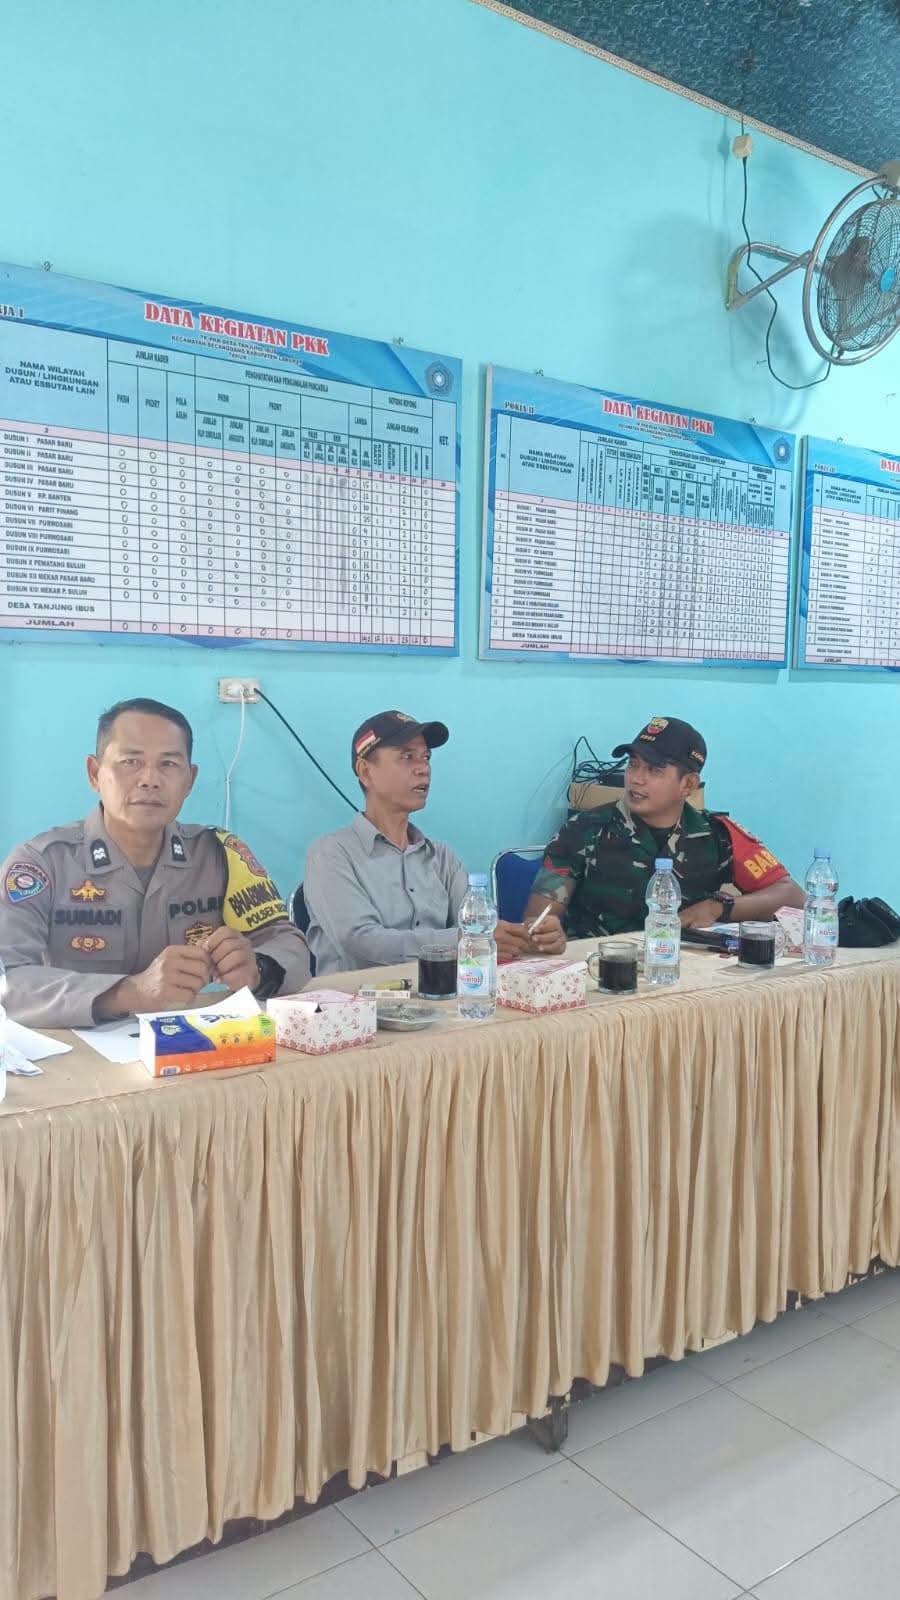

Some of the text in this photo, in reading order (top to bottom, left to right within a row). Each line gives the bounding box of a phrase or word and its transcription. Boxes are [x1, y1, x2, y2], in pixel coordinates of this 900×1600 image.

[20, 309, 23, 317] I
[144, 303, 329, 355] DATA KEGIATAN PKK
[172, 335, 206, 346] KECAMATAN
[20, 361, 85, 377] NAMA WILAYAH
[5, 367, 36, 378] DUSUN
[43, 372, 99, 387] LINGKUNGAN
[9, 376, 31, 385] ATAU
[76, 387, 95, 396] LAIN
[604, 399, 632, 417] DATA
[636, 406, 688, 429] KEGIATAN
[691, 418, 713, 434] PKK
[4, 433, 25, 442] DUSUN
[57, 440, 72, 448] BARU
[4, 448, 25, 456] DUSUN
[37, 451, 56, 459] PASAR
[58, 454, 73, 462] BARU
[5, 462, 25, 470] DUSUN
[38, 465, 56, 473] PASAR
[5, 476, 25, 484] DUSUN
[38, 479, 56, 487] PASAR
[5, 489, 25, 497] DUSUN
[5, 503, 26, 511] DUSUN
[57, 508, 78, 516] PINANG
[33, 603, 73, 611] TANJUNG
[26, 619, 74, 627] JUMLAH
[55, 910, 121, 926] SURIADI
[246, 905, 274, 927] POLSEK
